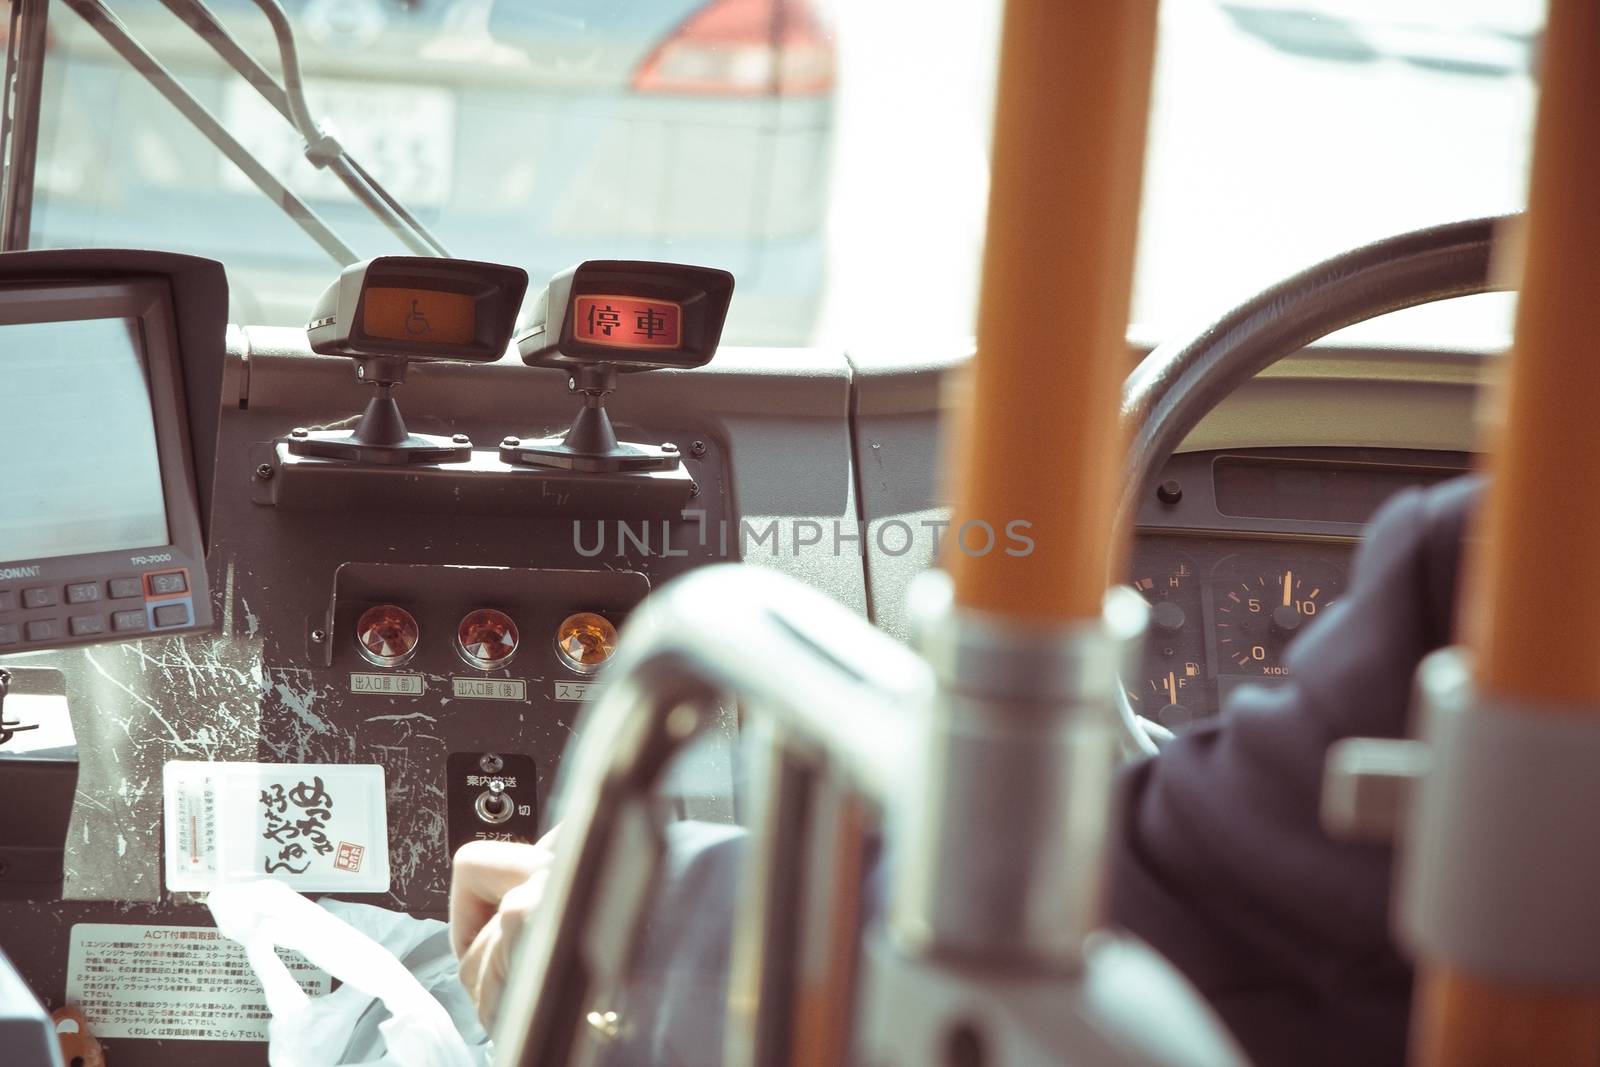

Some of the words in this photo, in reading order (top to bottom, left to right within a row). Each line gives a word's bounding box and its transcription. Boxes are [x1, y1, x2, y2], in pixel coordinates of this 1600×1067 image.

[588, 304, 667, 339] 停車
[1169, 577, 1179, 588] H
[1248, 599, 1261, 613] 5
[1295, 600, 1316, 616] 10
[1252, 645, 1265, 661] 0
[1178, 678, 1187, 689] F
[518, 804, 531, 817] 切
